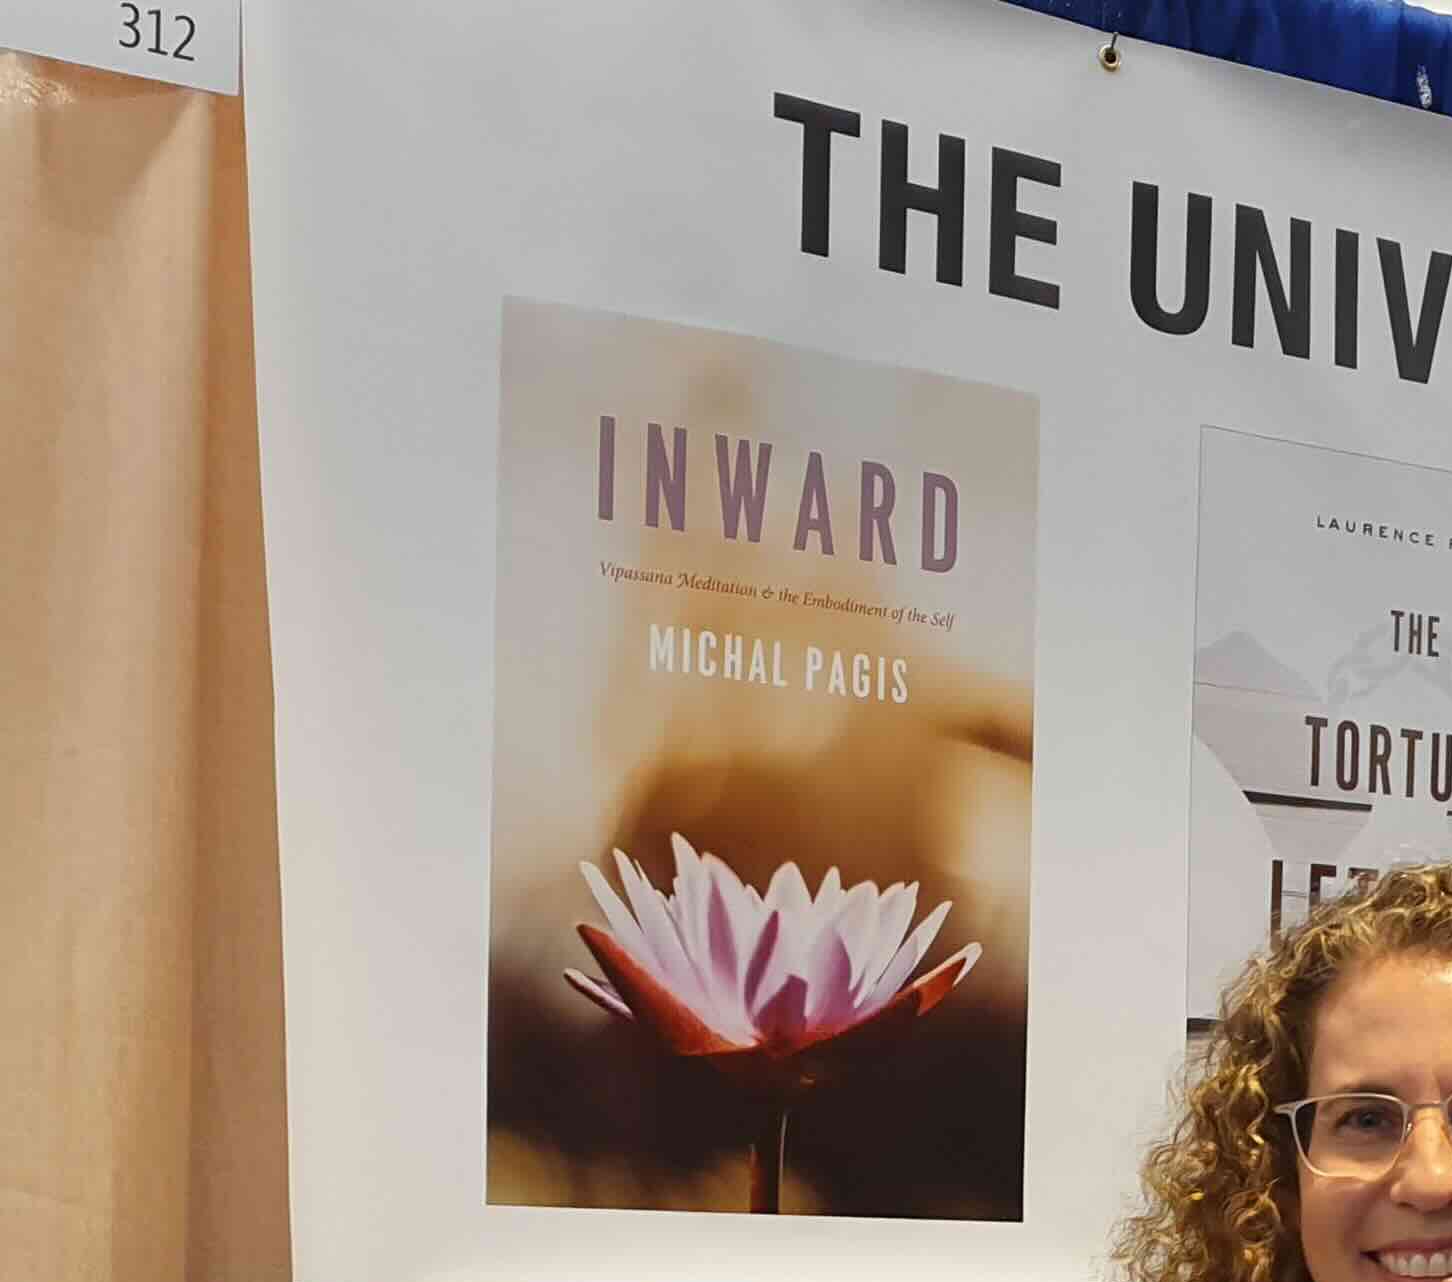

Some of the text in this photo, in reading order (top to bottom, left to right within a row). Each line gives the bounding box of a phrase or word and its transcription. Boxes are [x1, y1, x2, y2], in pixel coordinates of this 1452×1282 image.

[118, 2, 198, 62] 312
[773, 91, 1062, 309] THE
[598, 415, 959, 574] INWARD
[1316, 516, 1436, 547] LAURENCE
[600, 561, 954, 631] Vipassana Meditation & the Embodiment of the Self
[649, 624, 909, 703] MICHAL PAGIS
[1391, 610, 1440, 657] THE
